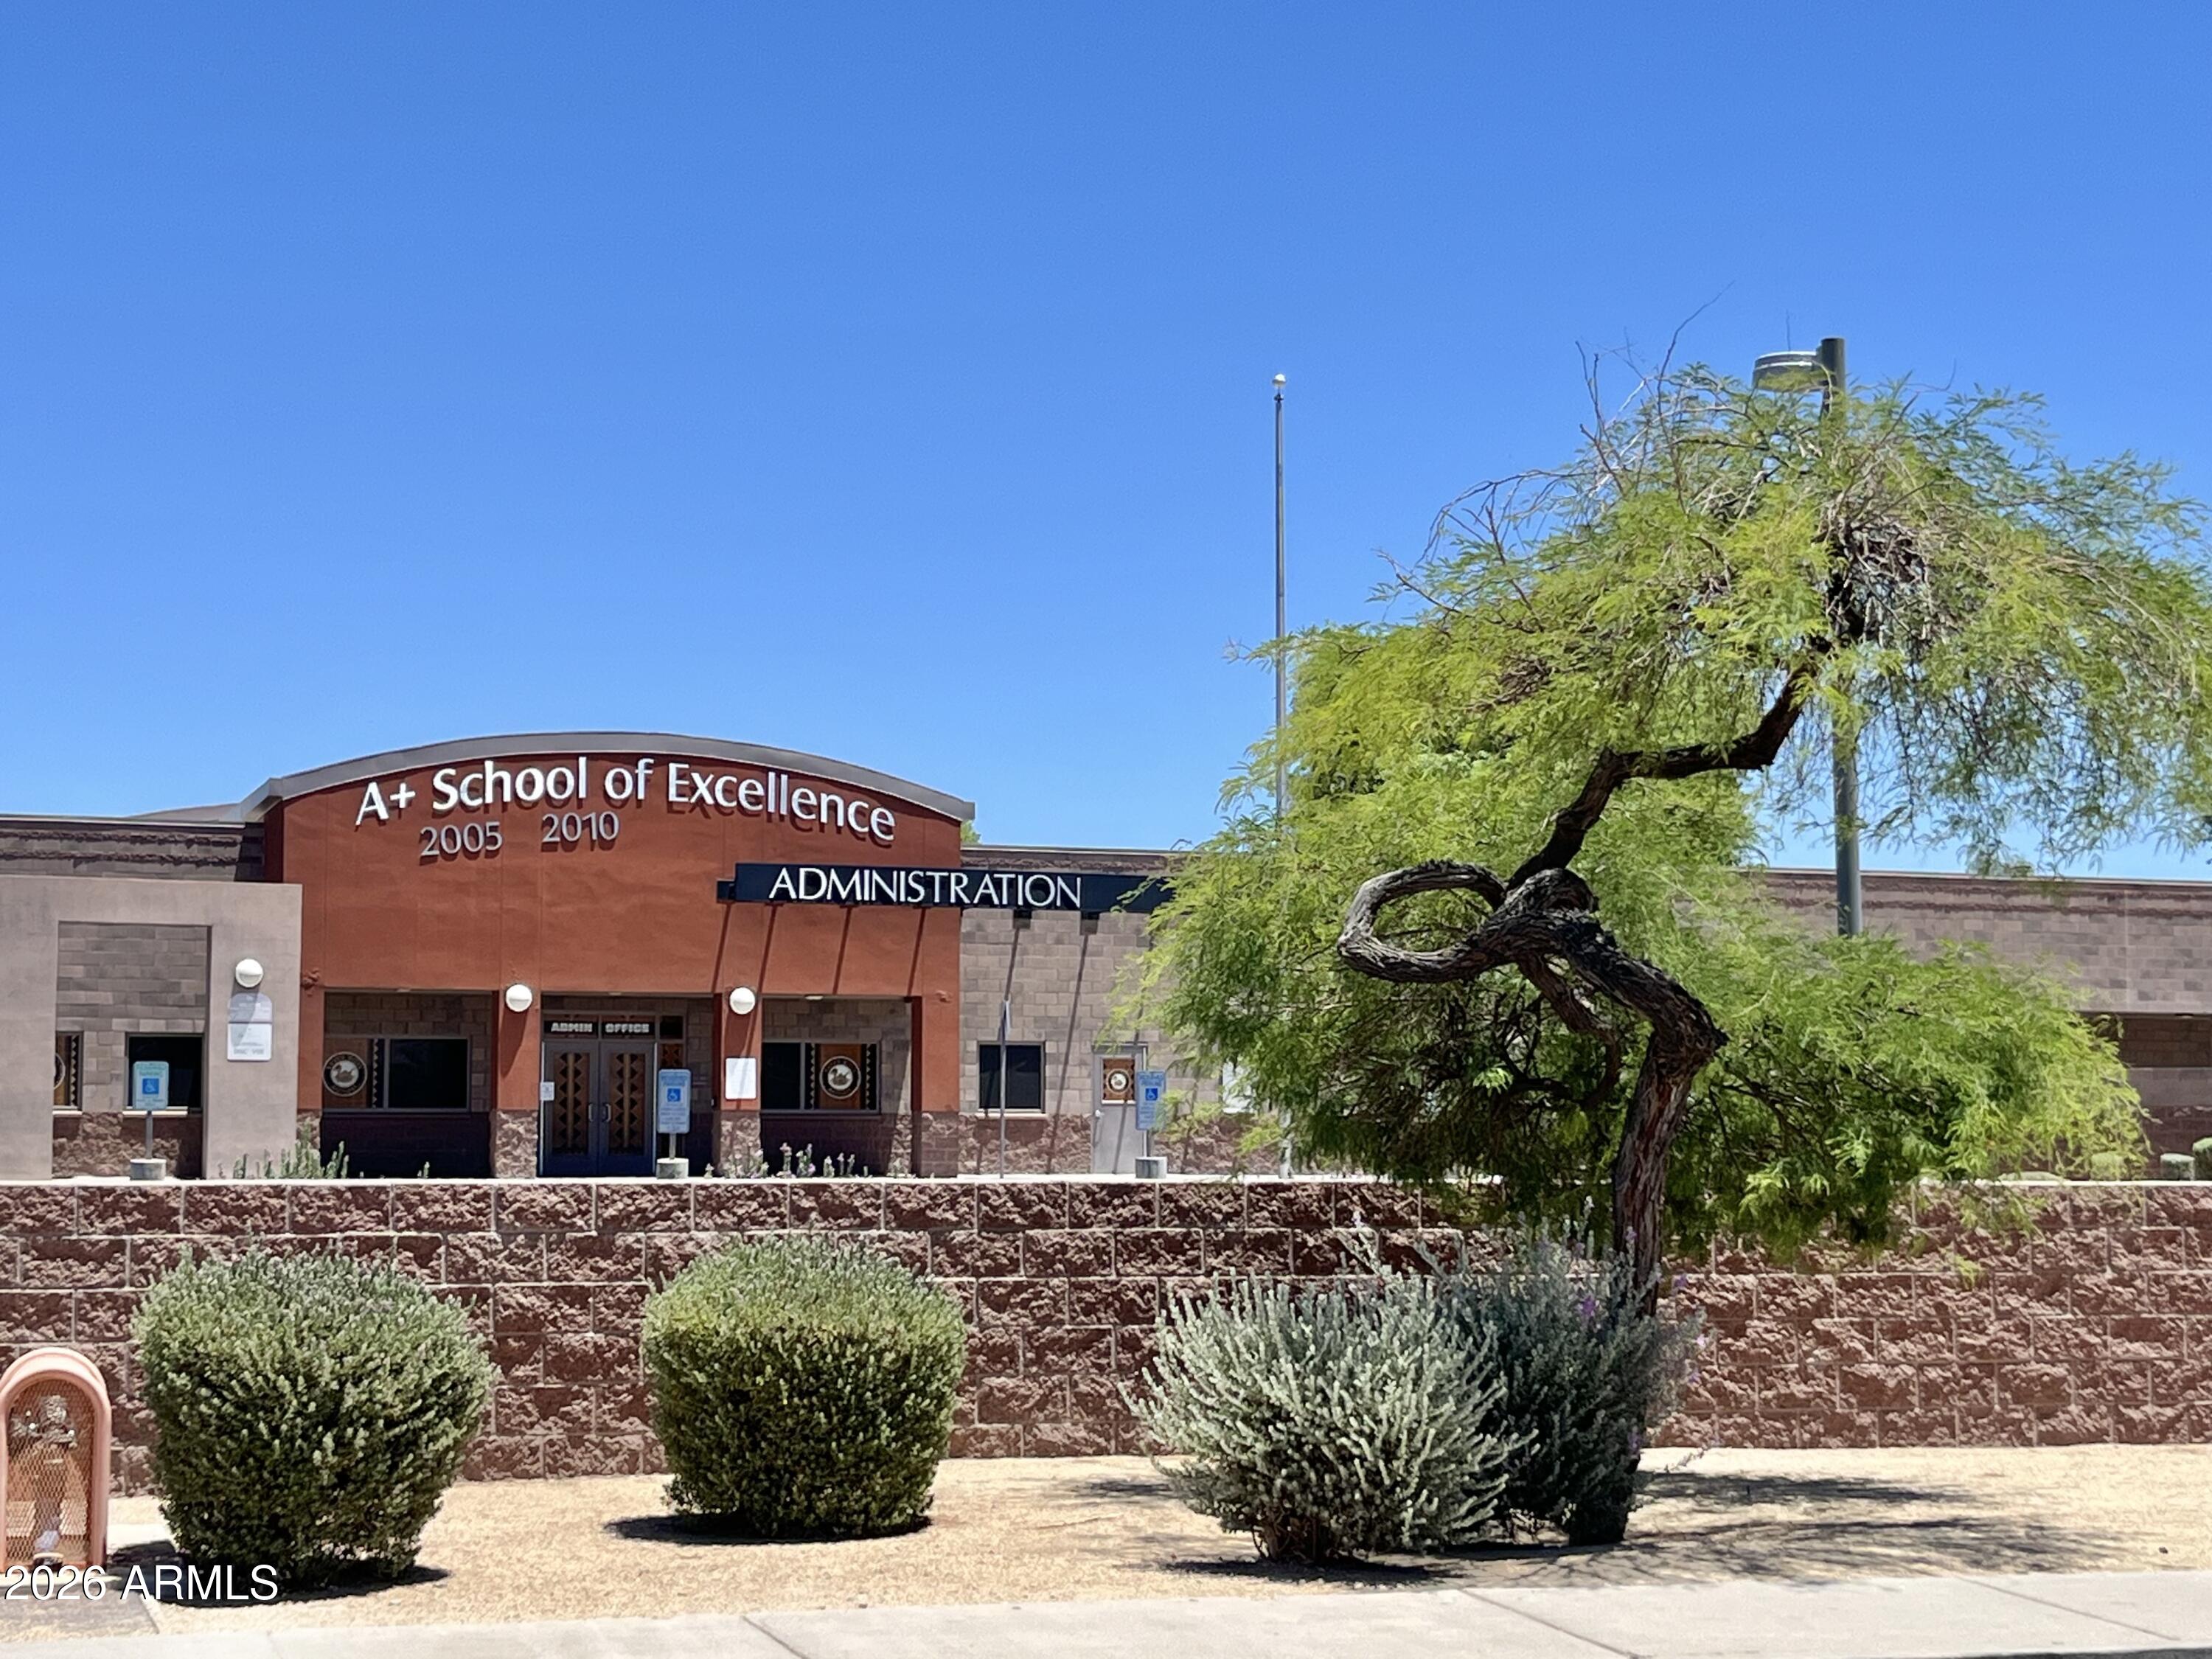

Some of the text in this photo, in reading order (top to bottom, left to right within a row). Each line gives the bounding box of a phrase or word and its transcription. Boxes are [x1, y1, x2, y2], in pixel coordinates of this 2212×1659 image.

[355, 757, 895, 841] A+ School of Excellence
[420, 811, 619, 857] 2005 2010
[768, 867, 1082, 908] ADMINISTRATION
[551, 1022, 649, 1033] ADMIN OFFICE
